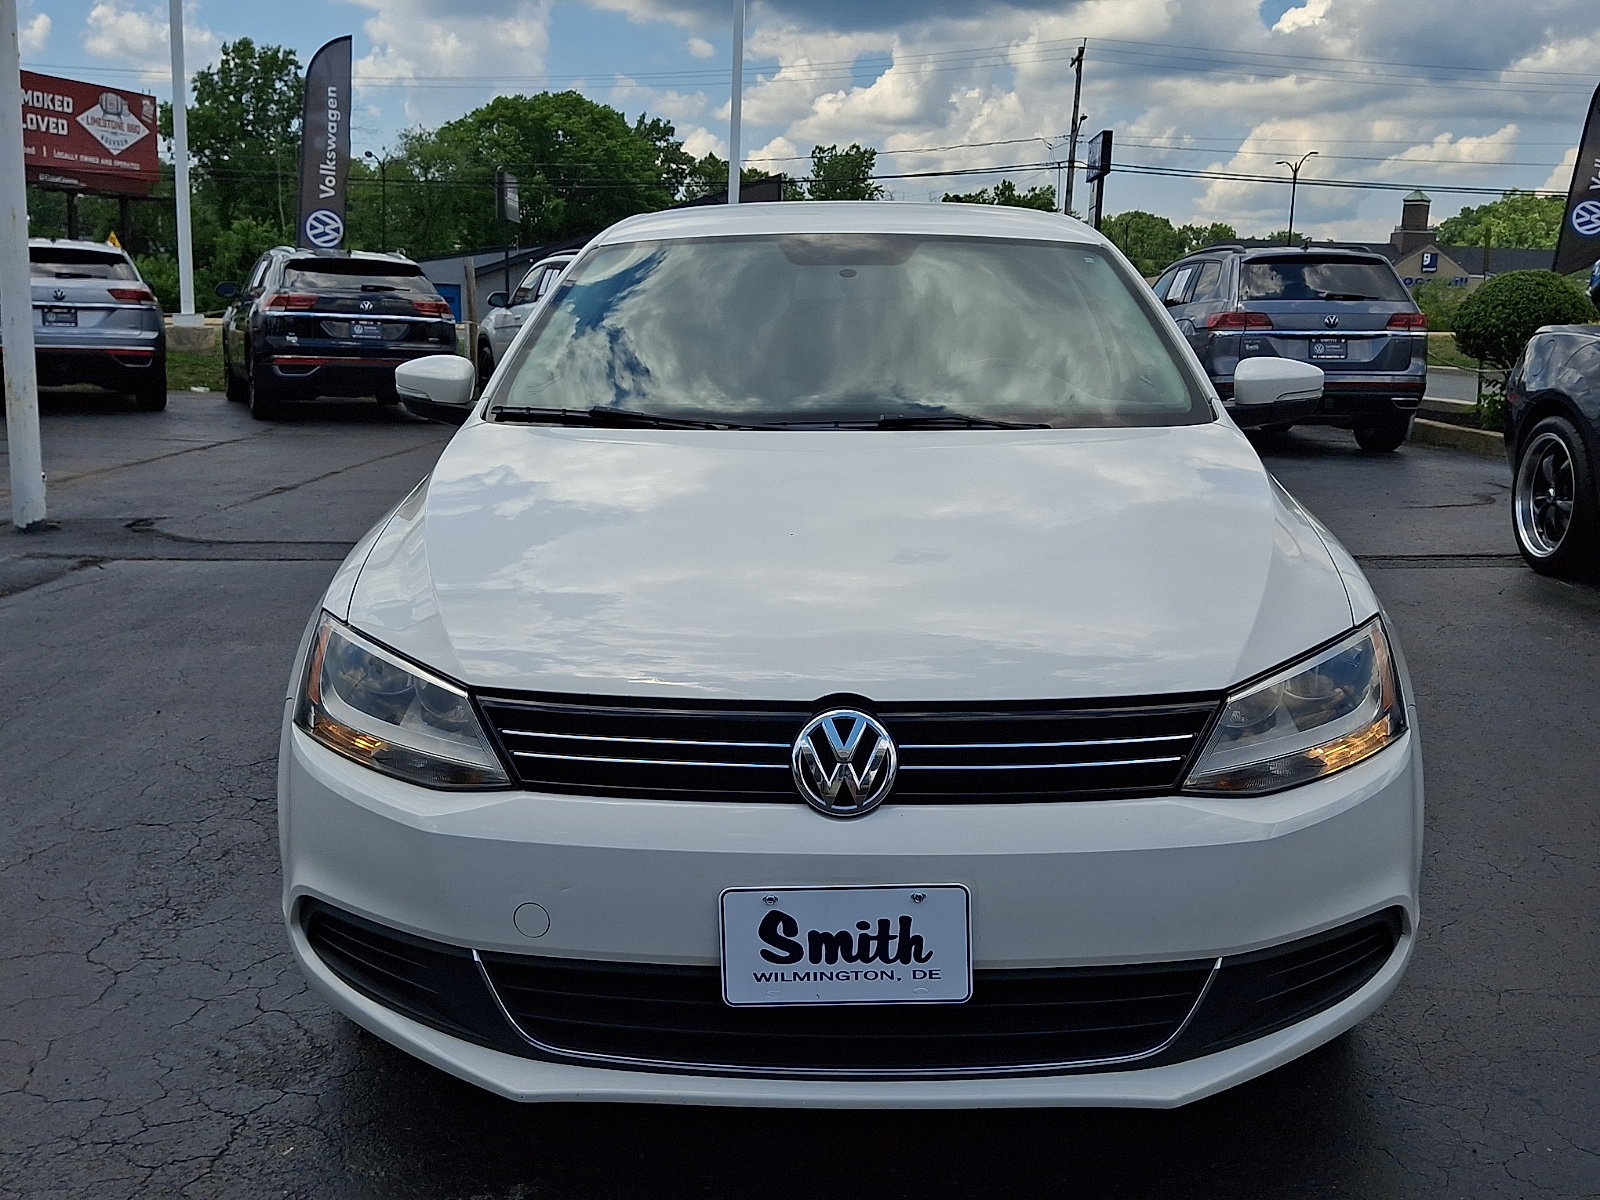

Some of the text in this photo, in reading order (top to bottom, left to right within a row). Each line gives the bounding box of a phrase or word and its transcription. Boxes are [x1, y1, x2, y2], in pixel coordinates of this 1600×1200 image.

[21, 88, 73, 113] MOKED
[23, 113, 68, 135] OVED
[319, 86, 341, 199] Volkswagen
[795, 711, 893, 811] VW
[758, 909, 934, 965] Smith
[753, 969, 942, 983] WILMINGTON, DE
